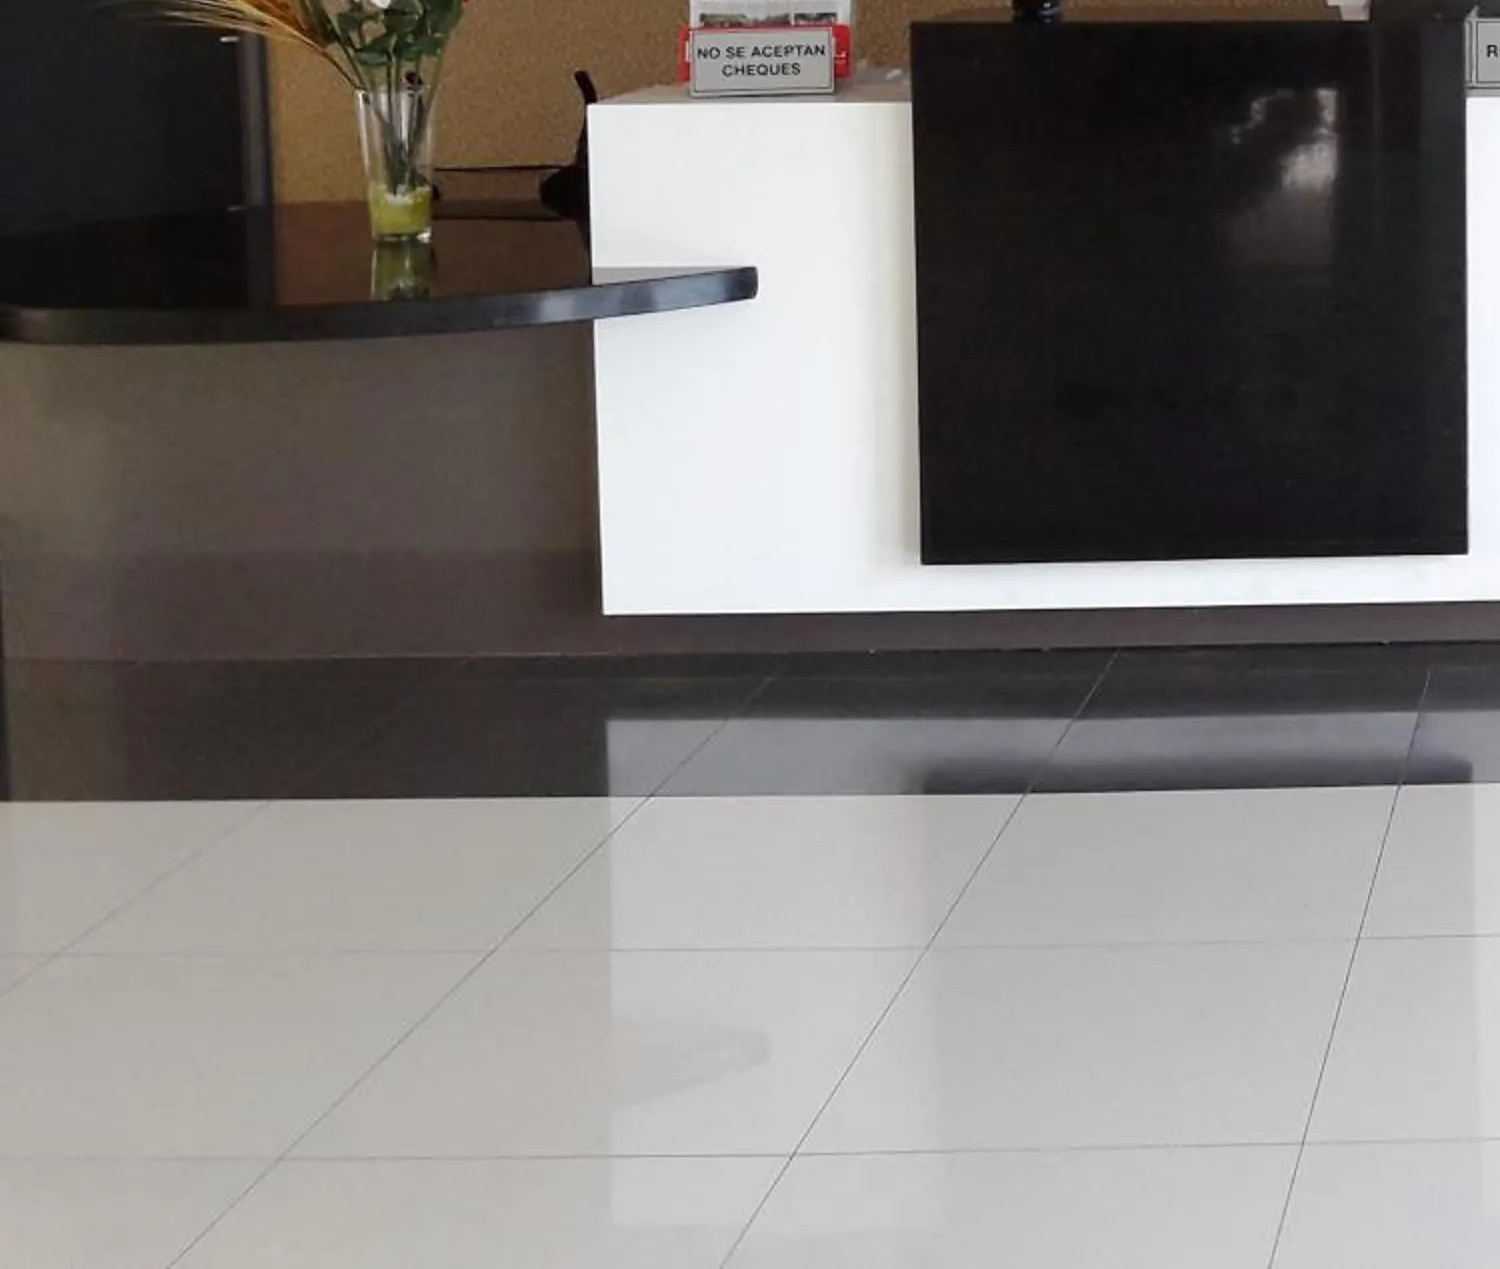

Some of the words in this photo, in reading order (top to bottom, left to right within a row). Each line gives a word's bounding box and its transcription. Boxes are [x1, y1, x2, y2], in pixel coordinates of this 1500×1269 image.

[697, 46, 721, 60] NO
[725, 46, 745, 59] SE
[751, 44, 826, 59] ACEPTAN
[721, 62, 802, 77] CHEQUES
